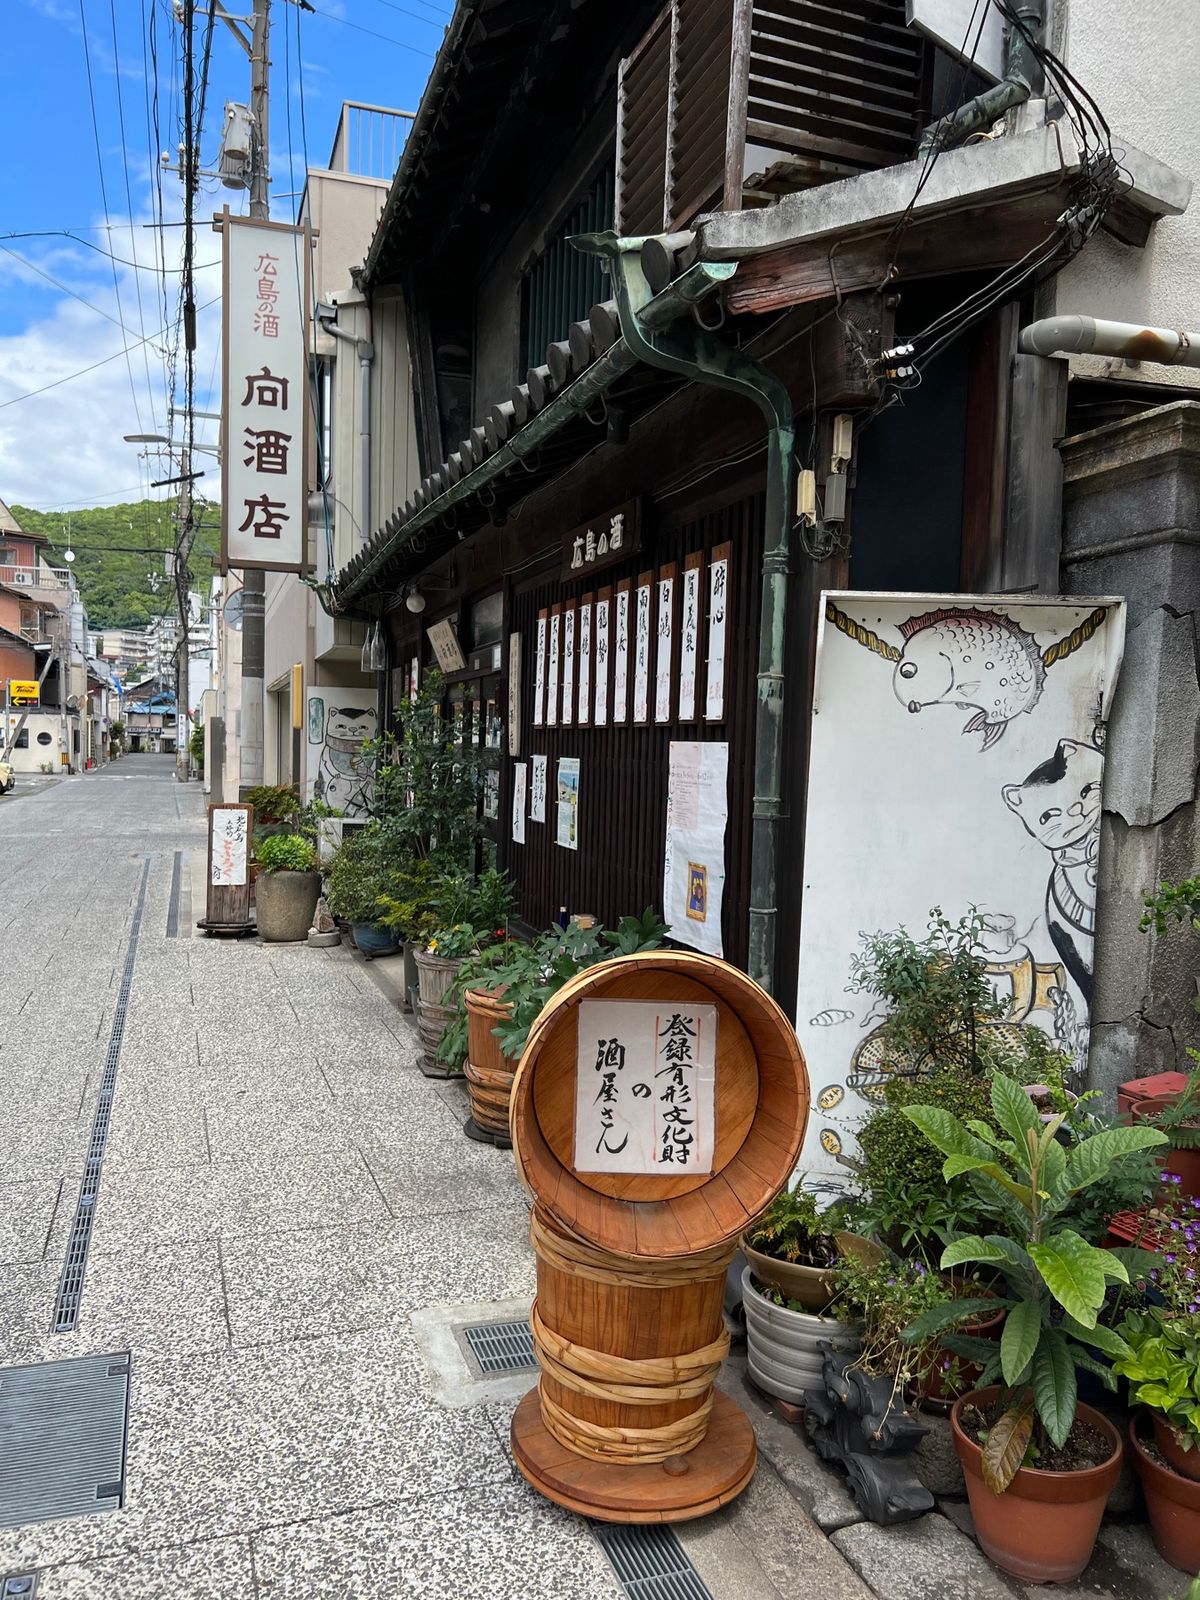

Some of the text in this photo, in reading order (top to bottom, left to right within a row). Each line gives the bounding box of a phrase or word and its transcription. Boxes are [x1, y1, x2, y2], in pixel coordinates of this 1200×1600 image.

[254, 253, 280, 338] 広島の酒
[238, 366, 292, 540] 向酒店
[571, 513, 624, 569] 広島の酒
[593, 1037, 629, 1154] 酒屋さん
[654, 1013, 697, 1165] 登録有形文化財
